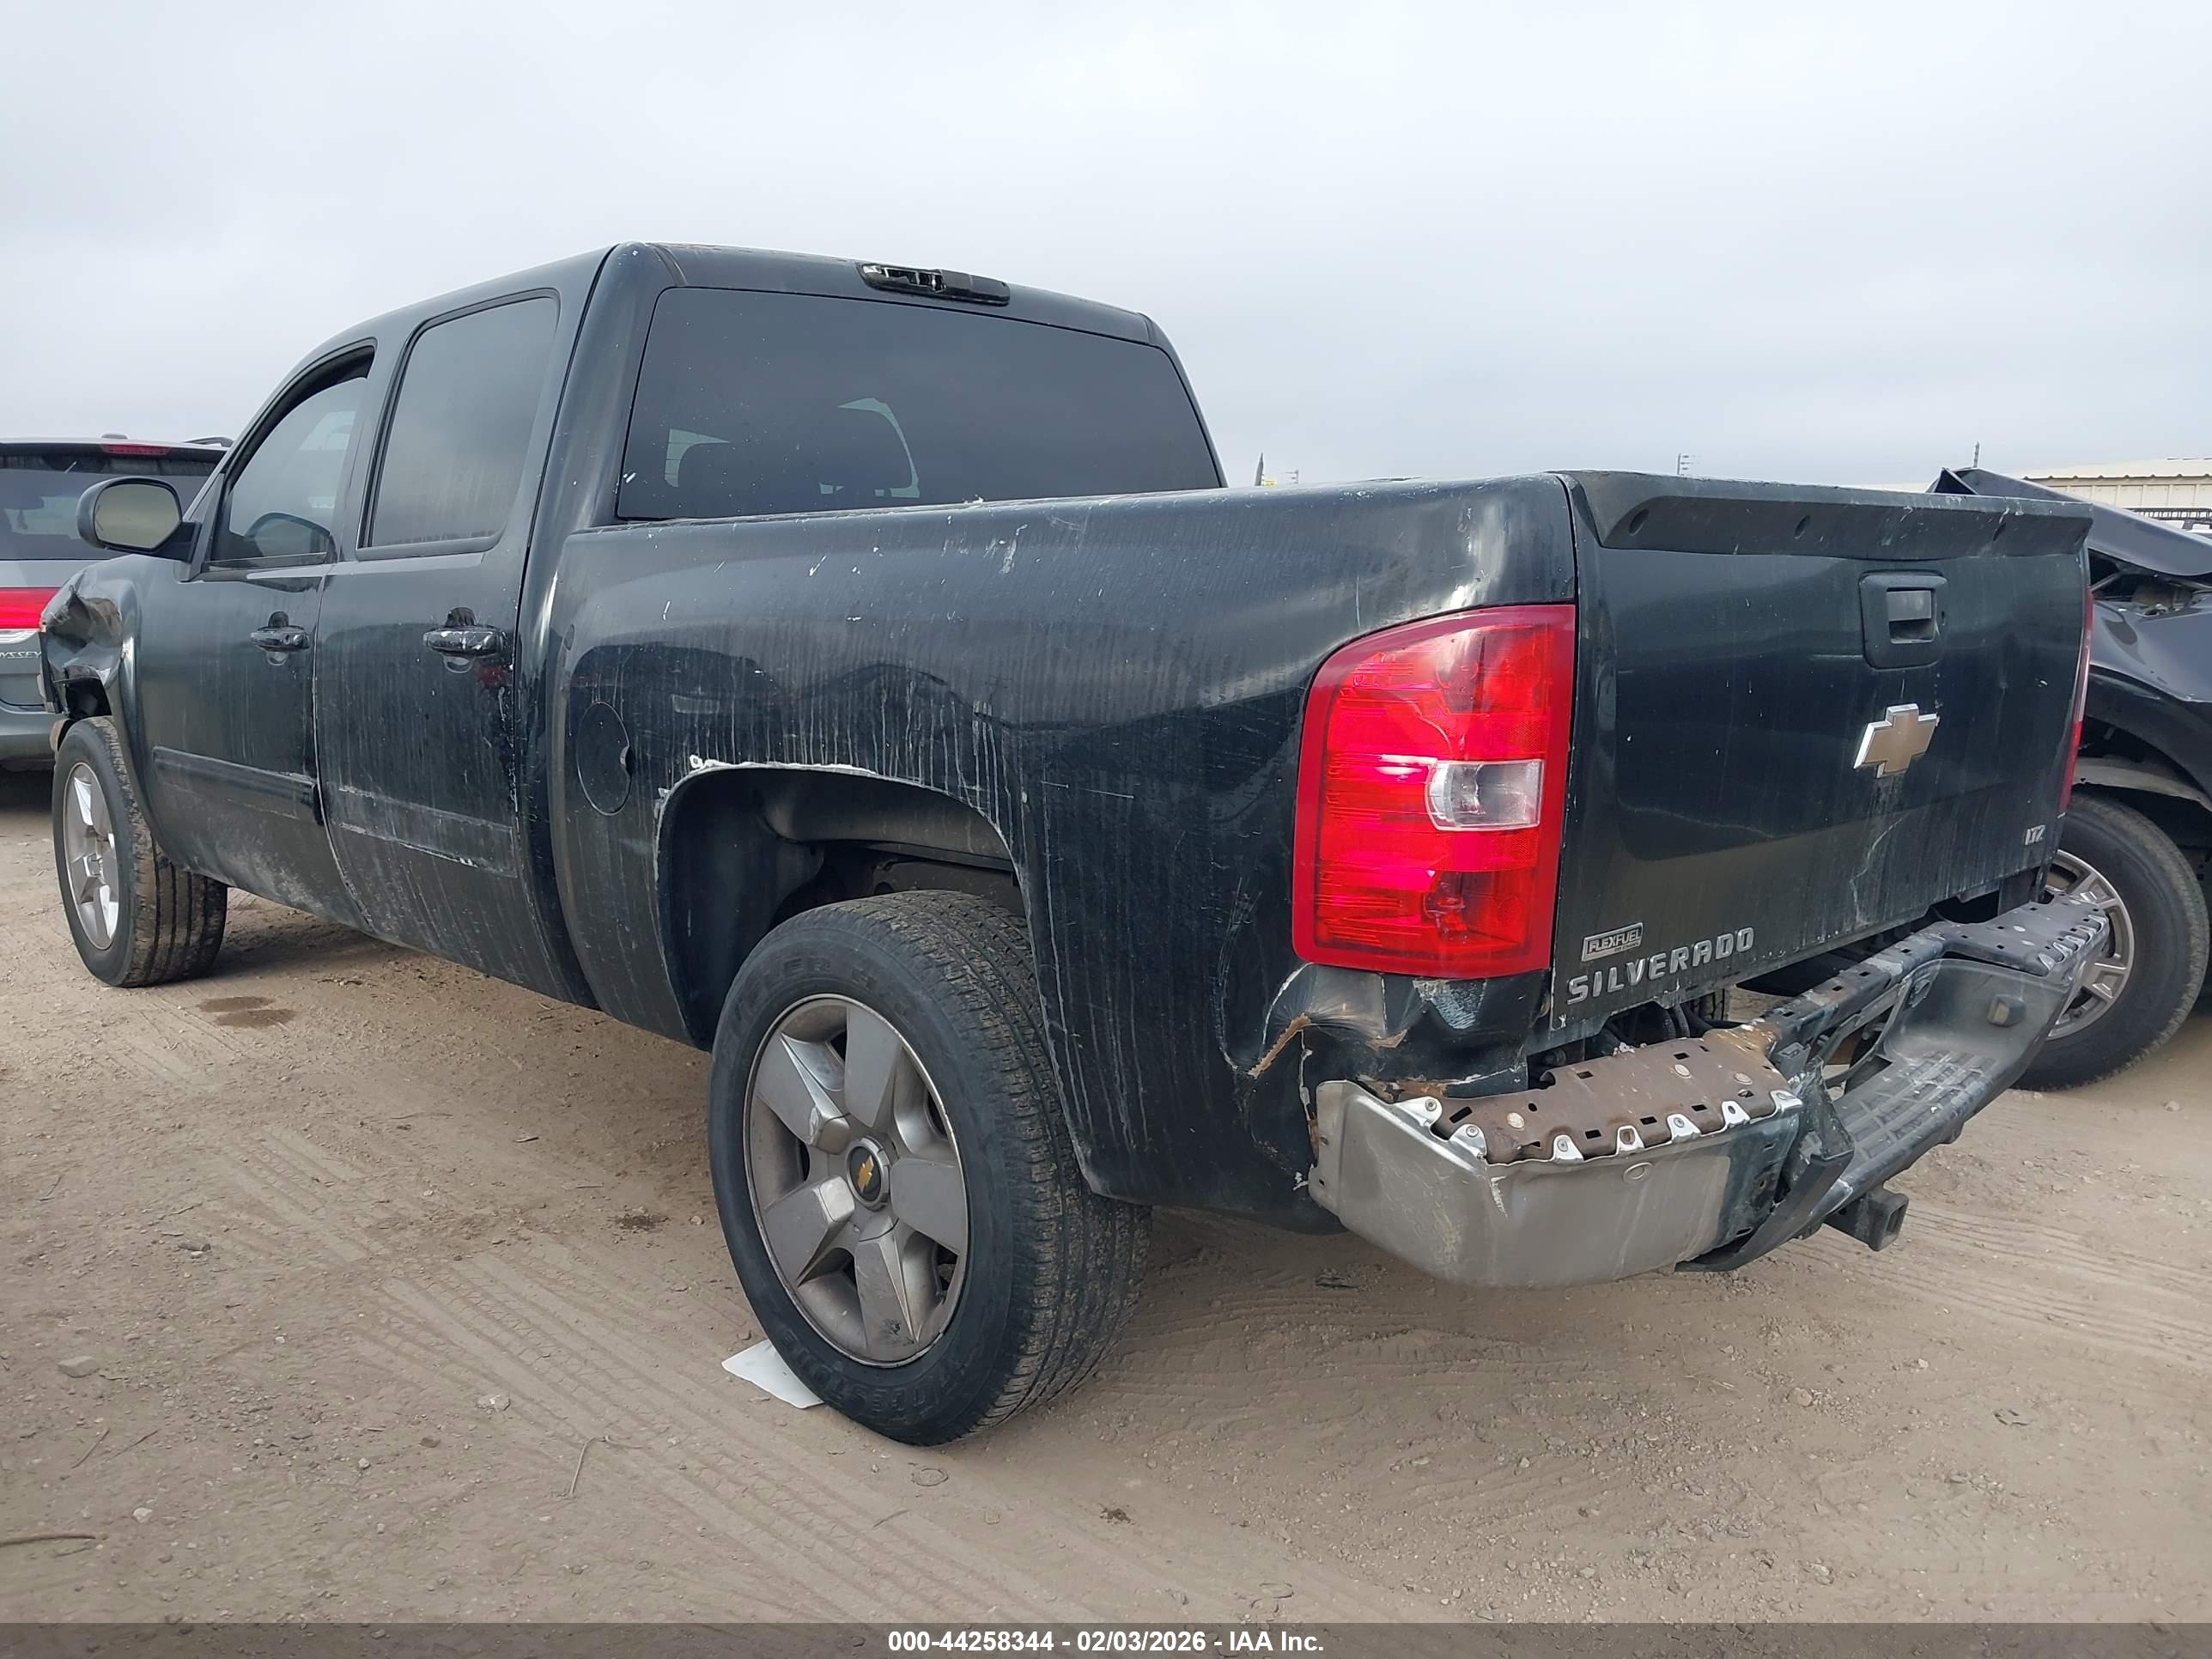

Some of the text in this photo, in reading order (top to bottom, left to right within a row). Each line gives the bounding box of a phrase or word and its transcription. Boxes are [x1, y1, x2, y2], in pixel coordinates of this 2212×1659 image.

[0, 651, 41, 659] YSSEY
[1589, 928, 1641, 953] FLEXFUEL
[1567, 927, 1754, 1005] SILVERADO
